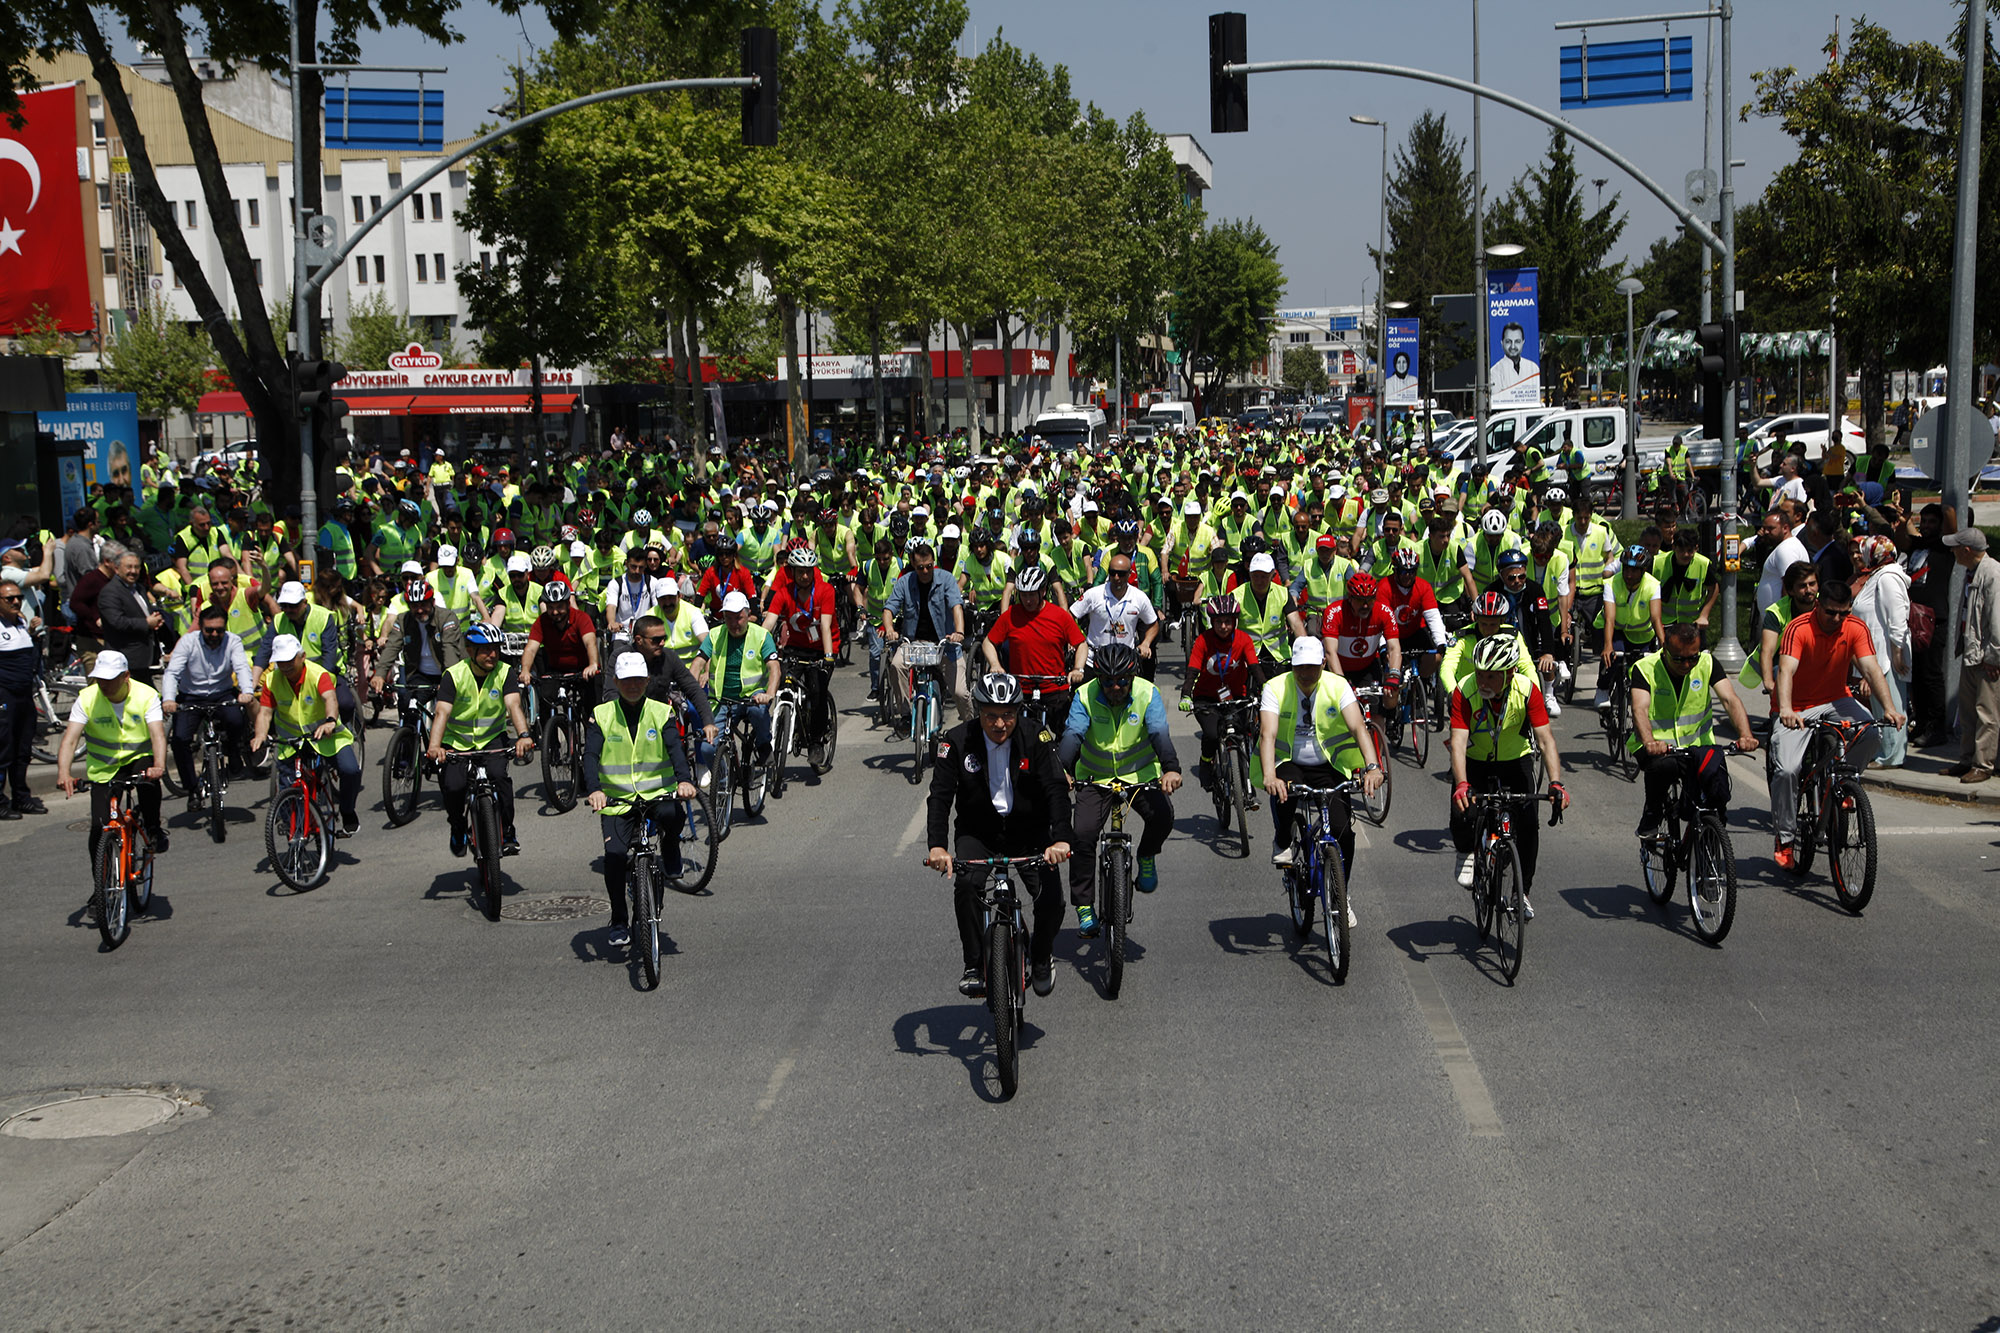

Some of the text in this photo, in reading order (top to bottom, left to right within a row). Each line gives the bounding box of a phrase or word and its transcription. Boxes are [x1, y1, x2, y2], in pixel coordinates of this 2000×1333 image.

[1490, 282, 1504, 295] 21
[1490, 298, 1535, 308] MARMARA
[1490, 307, 1510, 317] GÖZ
[1388, 326, 1398, 335] 21
[806, 367, 854, 376] ÜYÜKŞEHİR
[90, 400, 131, 411] BELEDİYESİ
[53, 421, 104, 441] HAFTASI
